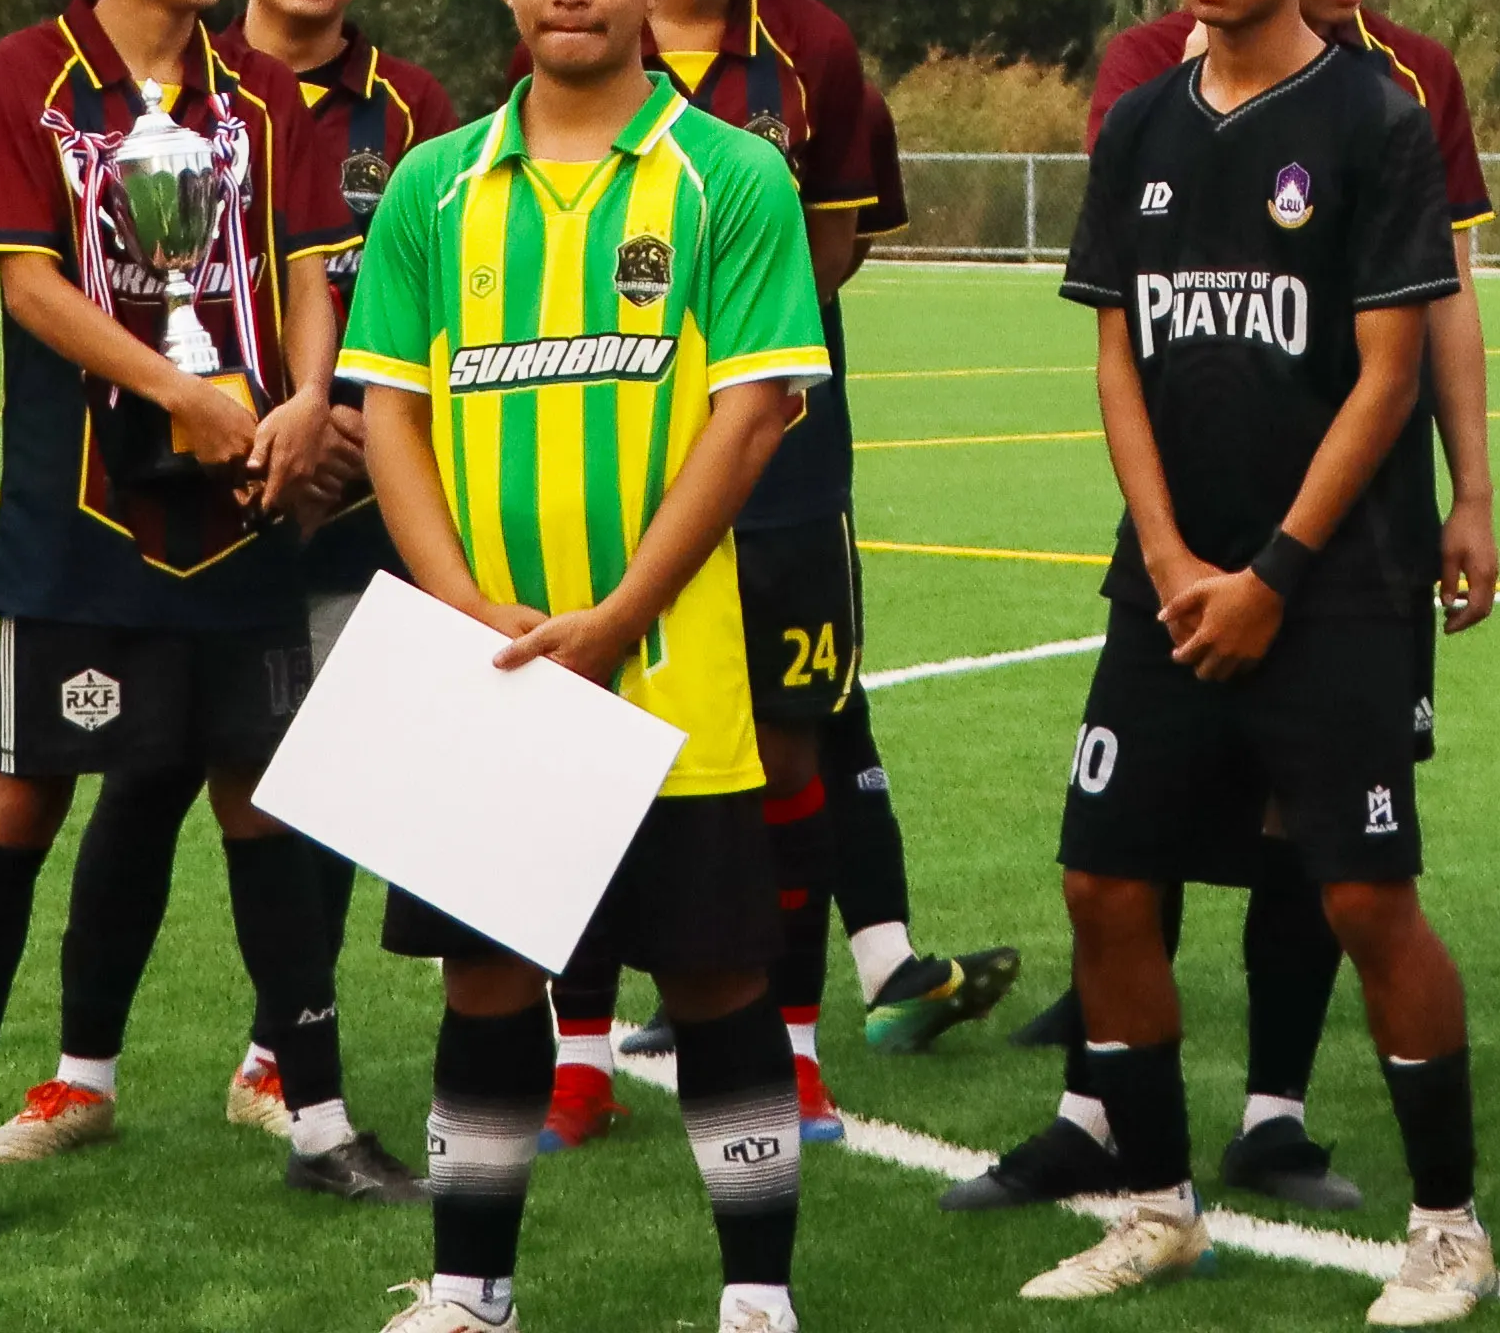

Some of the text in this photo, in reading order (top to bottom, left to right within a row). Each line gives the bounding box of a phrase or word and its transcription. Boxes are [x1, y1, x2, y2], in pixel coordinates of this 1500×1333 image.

[1251, 271, 1270, 290] OF
[450, 335, 674, 387] SURABDIN
[782, 622, 838, 688] 24
